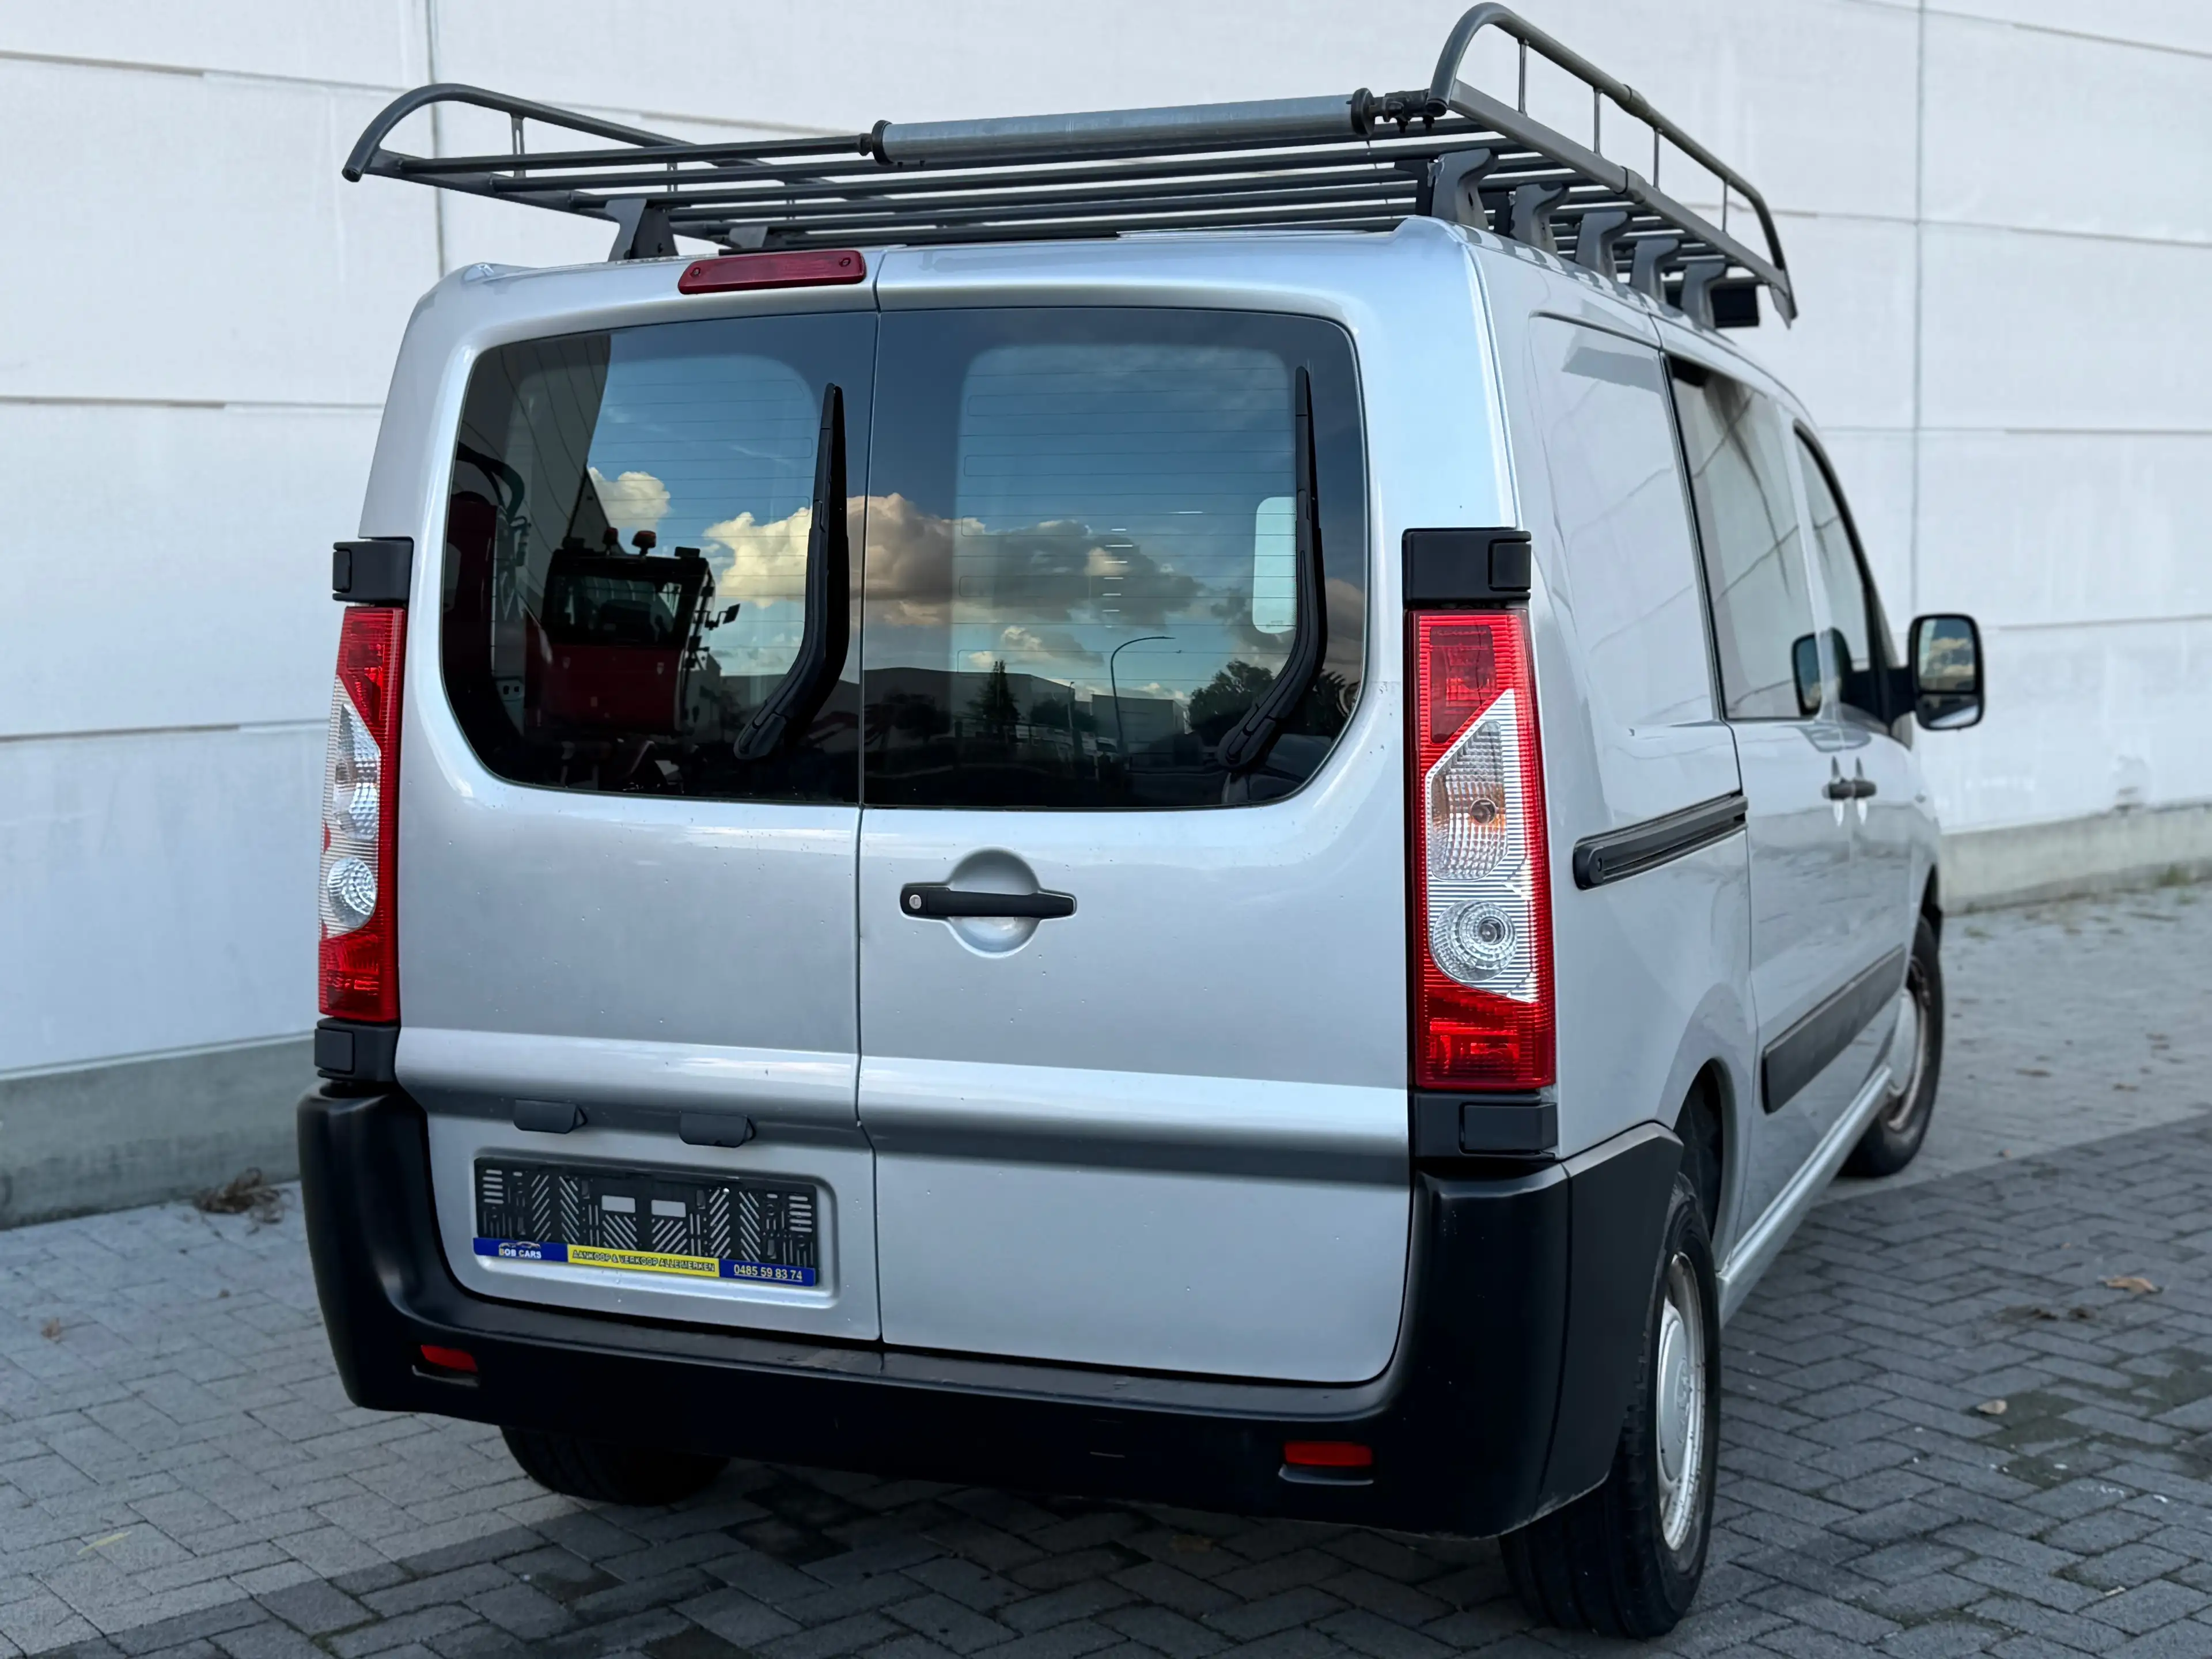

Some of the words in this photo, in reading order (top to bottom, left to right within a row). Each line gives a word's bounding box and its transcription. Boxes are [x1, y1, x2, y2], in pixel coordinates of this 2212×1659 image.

[519, 1249, 541, 1259] CARS
[573, 1249, 611, 1262] AANKOOP
[619, 1255, 658, 1266] VERKOOP
[734, 1264, 758, 1276] 0485
[760, 1267, 772, 1277] 59
[775, 1268, 787, 1279] 83
[790, 1270, 802, 1281] 74
